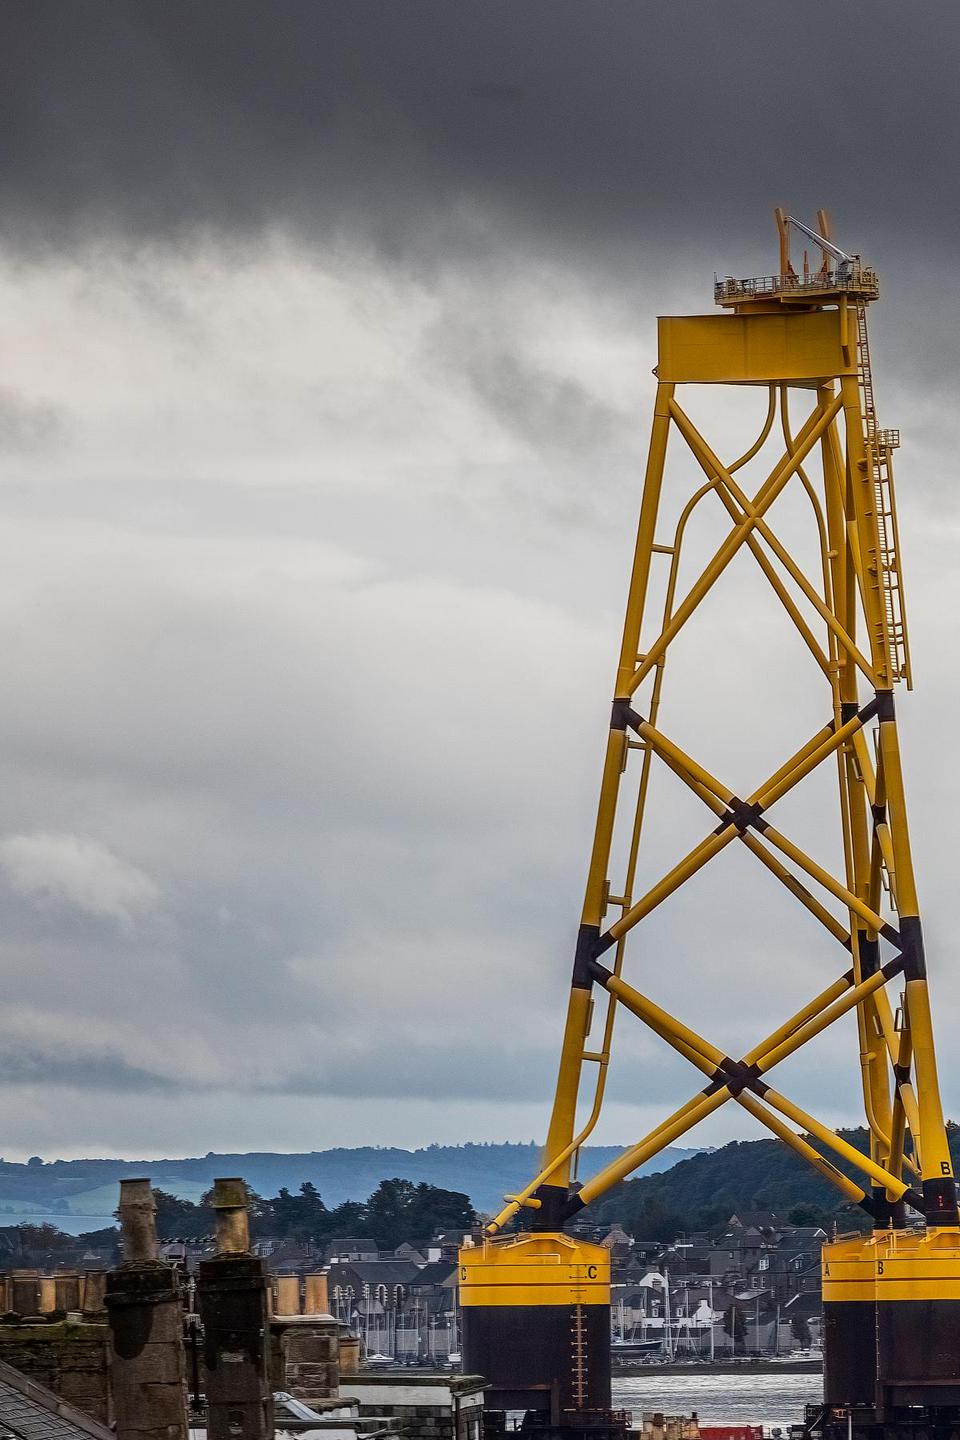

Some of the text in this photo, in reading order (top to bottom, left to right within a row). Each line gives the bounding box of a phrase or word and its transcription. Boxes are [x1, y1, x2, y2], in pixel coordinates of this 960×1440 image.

[940, 1161, 951, 1175] B
[461, 1267, 467, 1281] C
[587, 1265, 597, 1279] C
[824, 1263, 830, 1277] A
[877, 1261, 884, 1275] B
